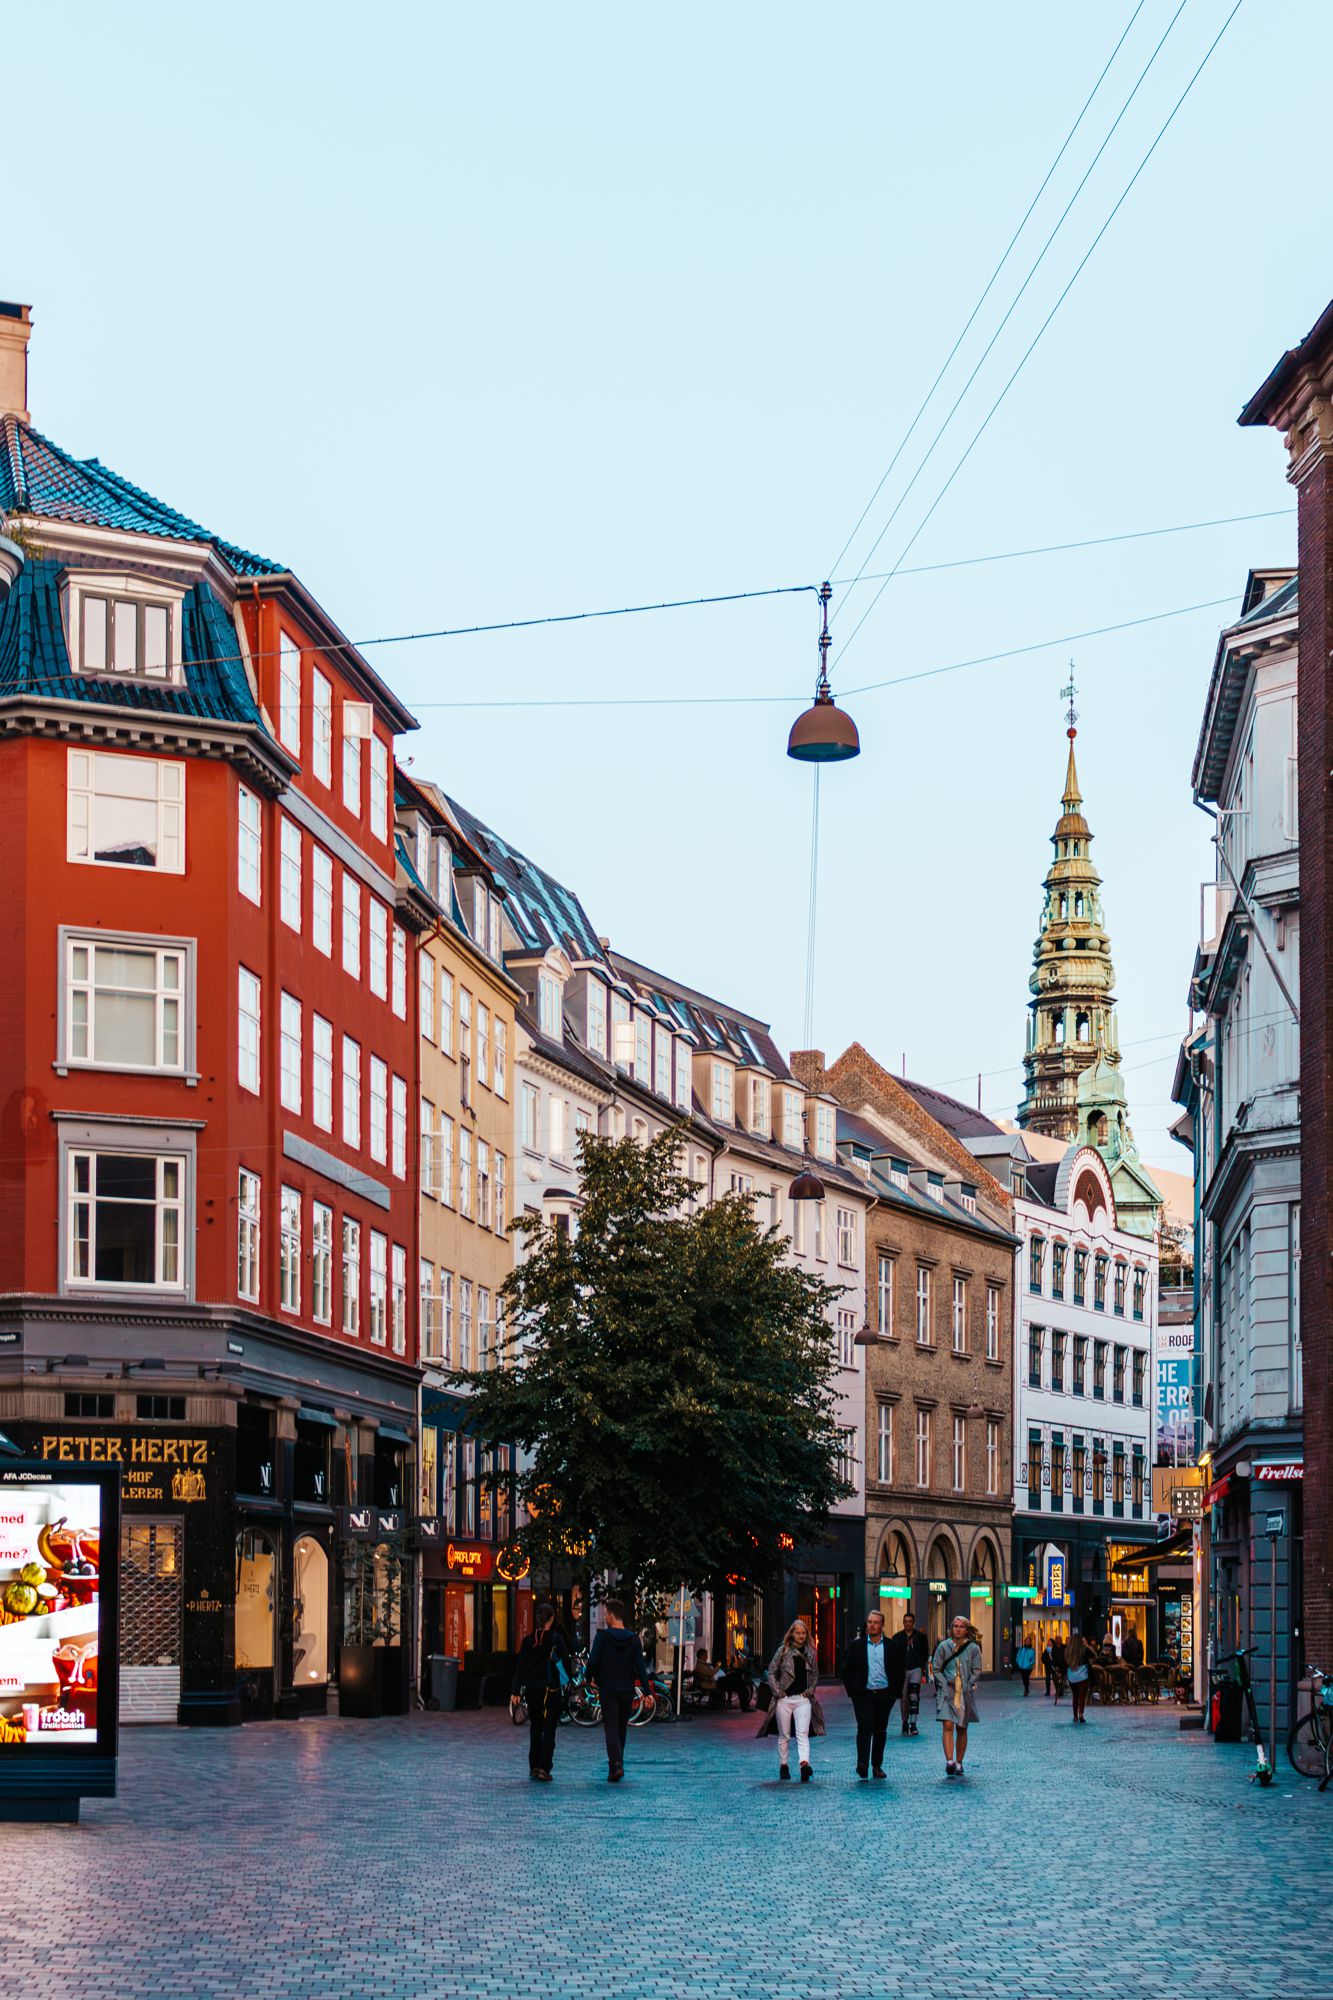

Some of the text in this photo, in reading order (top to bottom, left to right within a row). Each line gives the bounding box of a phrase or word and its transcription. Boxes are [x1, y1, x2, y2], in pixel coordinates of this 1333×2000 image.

[42, 1436, 208, 1464] PETER HERTZ
[121, 1487, 163, 1499] LERER
[349, 1510, 371, 1527] NÜ
[378, 1514, 399, 1531] NÜ
[420, 1519, 440, 1536] NÜ
[1050, 1563, 1063, 1599] matas
